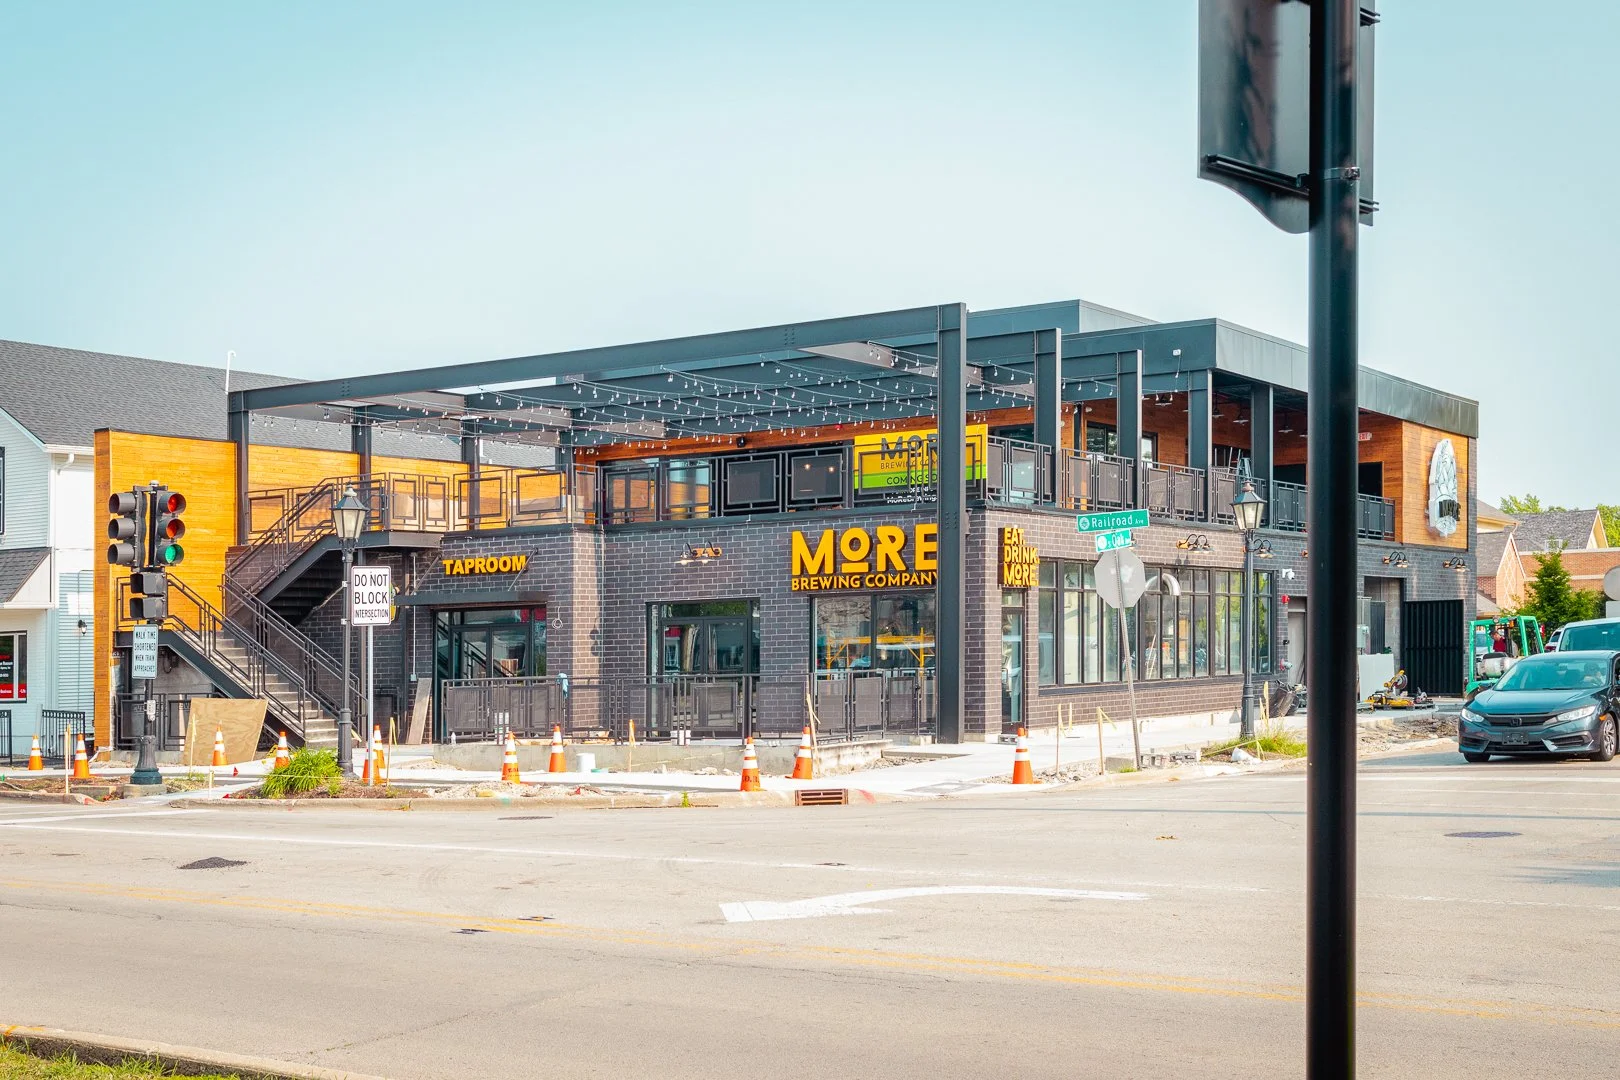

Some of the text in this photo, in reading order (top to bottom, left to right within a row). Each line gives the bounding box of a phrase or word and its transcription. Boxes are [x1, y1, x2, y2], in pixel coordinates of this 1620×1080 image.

[880, 433, 938, 460] MOR
[886, 474, 923, 485] COMNG
[1091, 515, 1133, 529] Railroad
[791, 523, 938, 576] MORE
[442, 554, 527, 576] TAPROOM
[354, 574, 388, 587] DO NOT
[791, 575, 862, 591] BREWING
[354, 591, 388, 605] BLOCK
[354, 608, 389, 619] NTERSECTION
[135, 631, 156, 640] WALK TIME
[134, 642, 156, 651] SHORTENED
